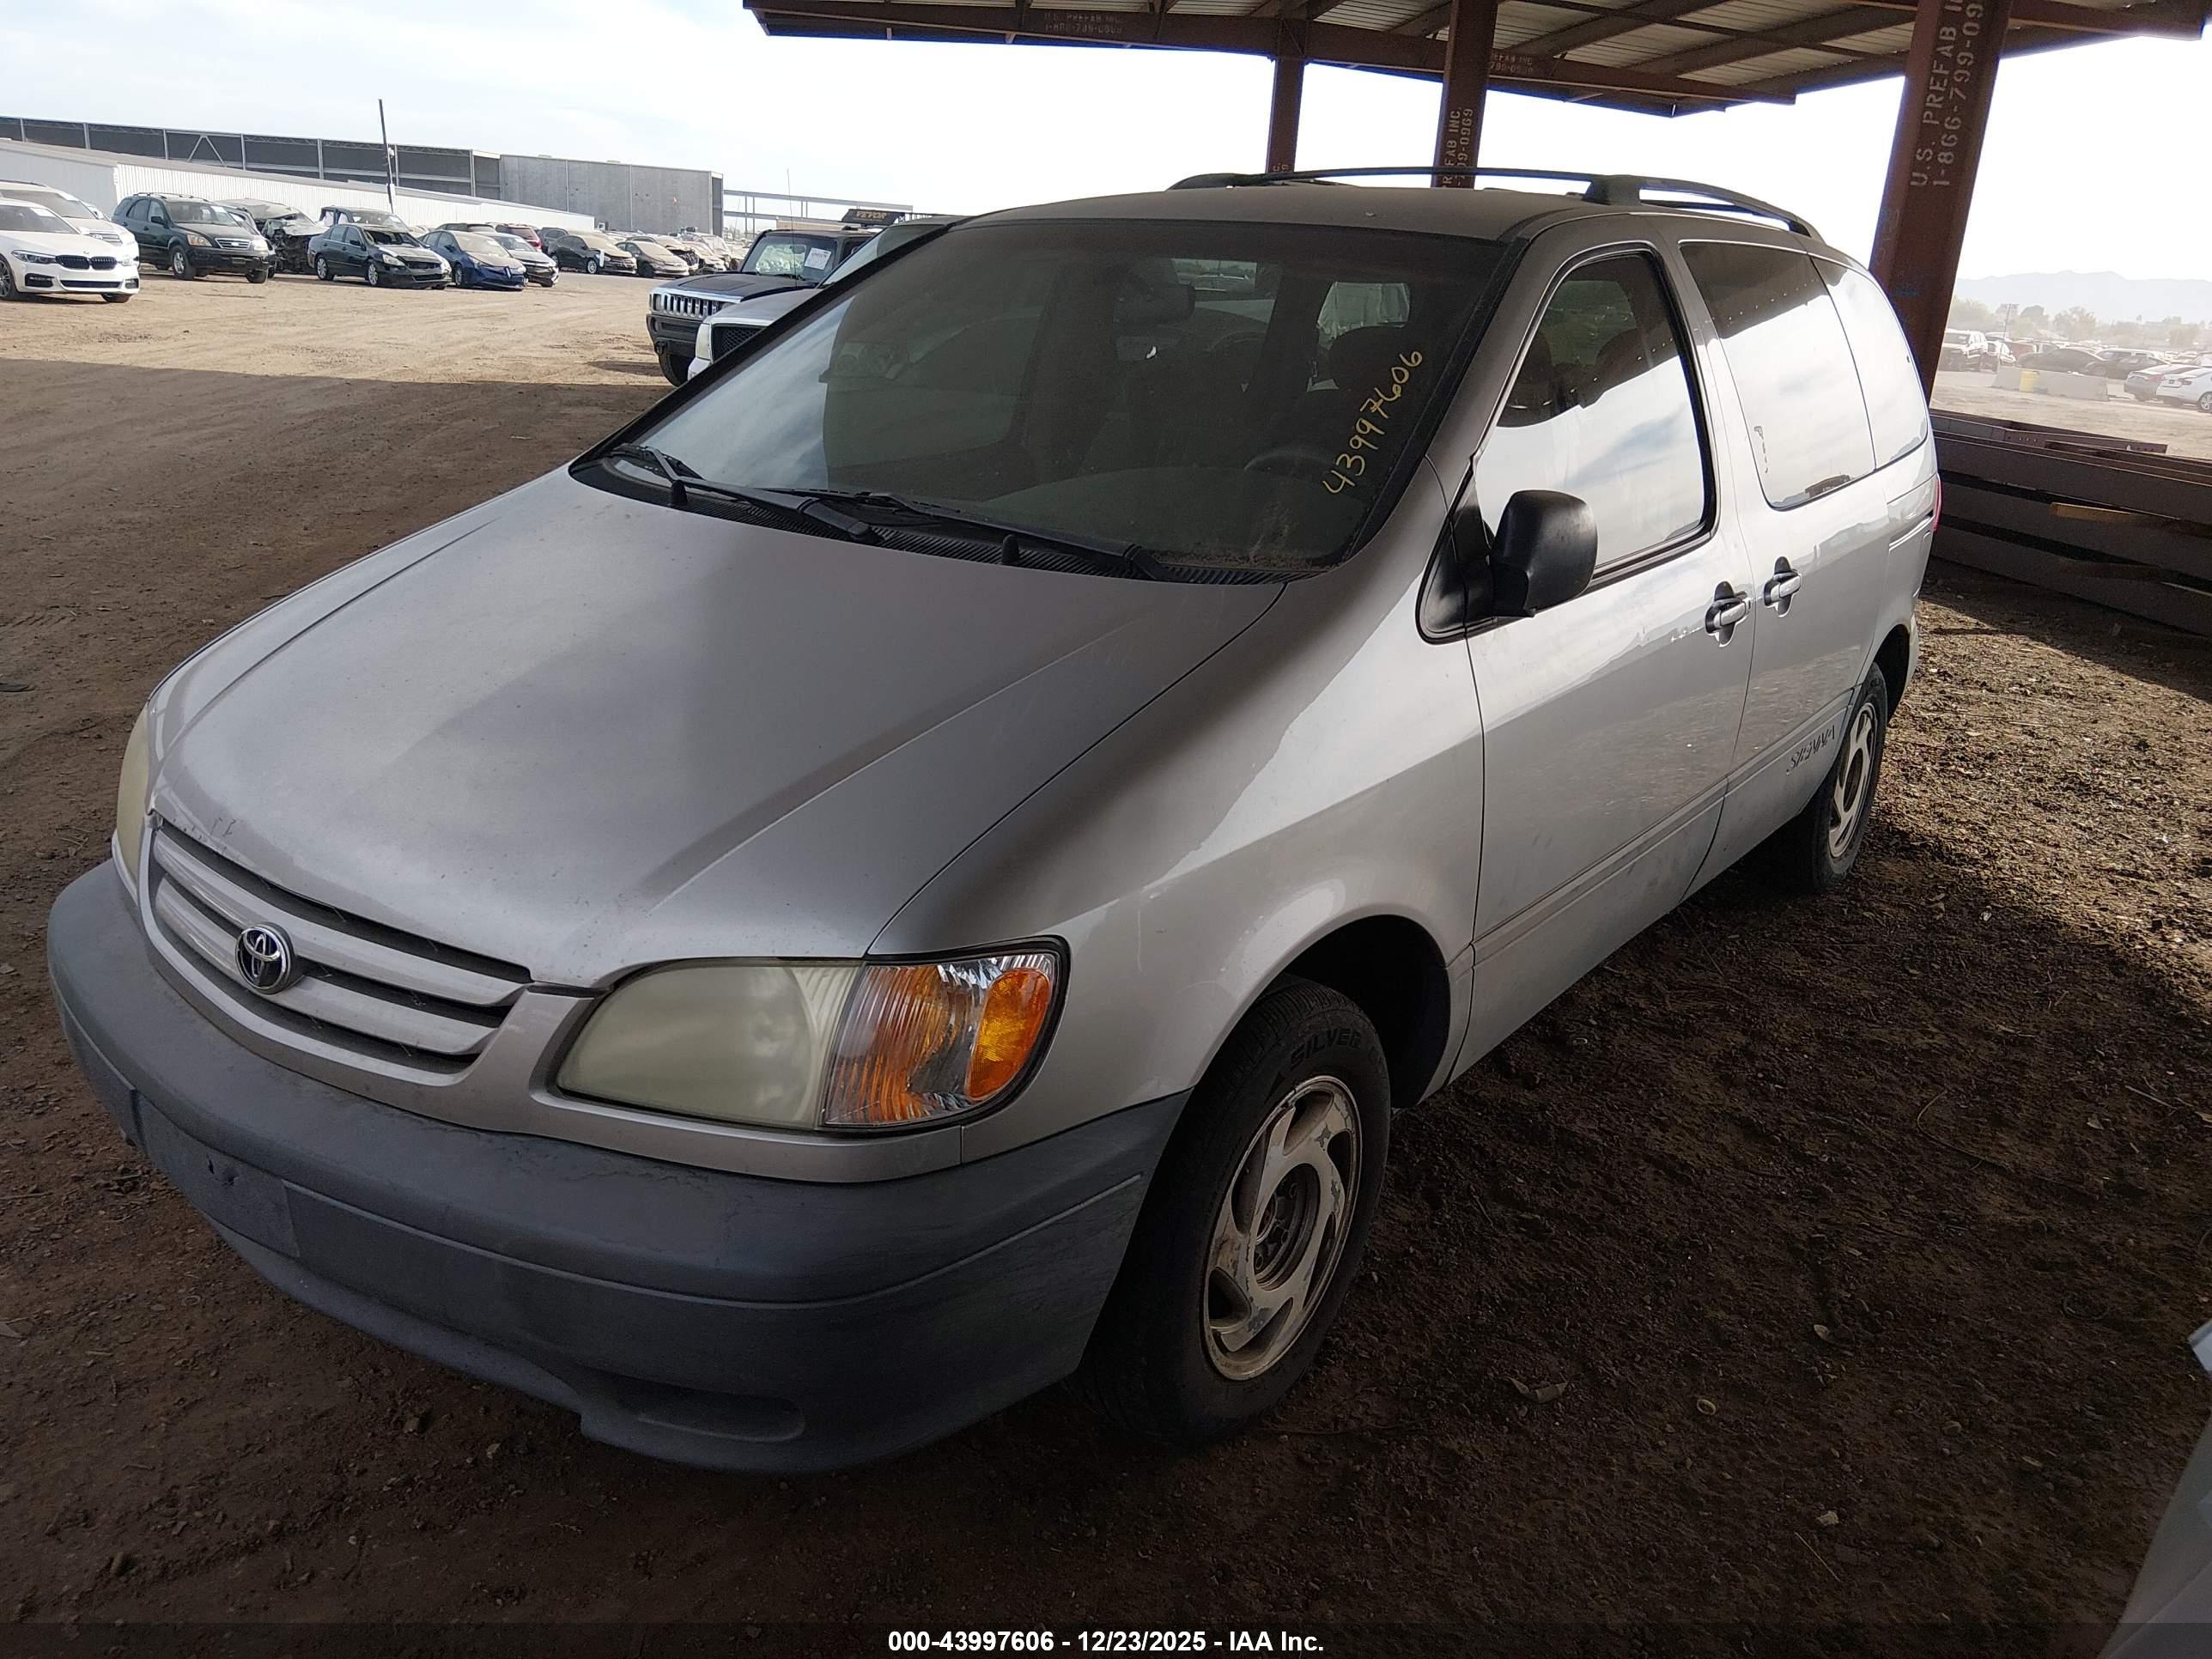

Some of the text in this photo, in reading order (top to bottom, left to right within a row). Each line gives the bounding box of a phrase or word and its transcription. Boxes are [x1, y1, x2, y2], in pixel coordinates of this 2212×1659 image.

[1922, 27, 1957, 125] PREFAB
[1443, 106, 1462, 188] RFAB INC.
[1910, 142, 1936, 187] U.S.
[855, 210, 888, 221] VEVOR
[1322, 350, 1424, 495] 43997606
[1786, 725, 1835, 775] SIENNA
